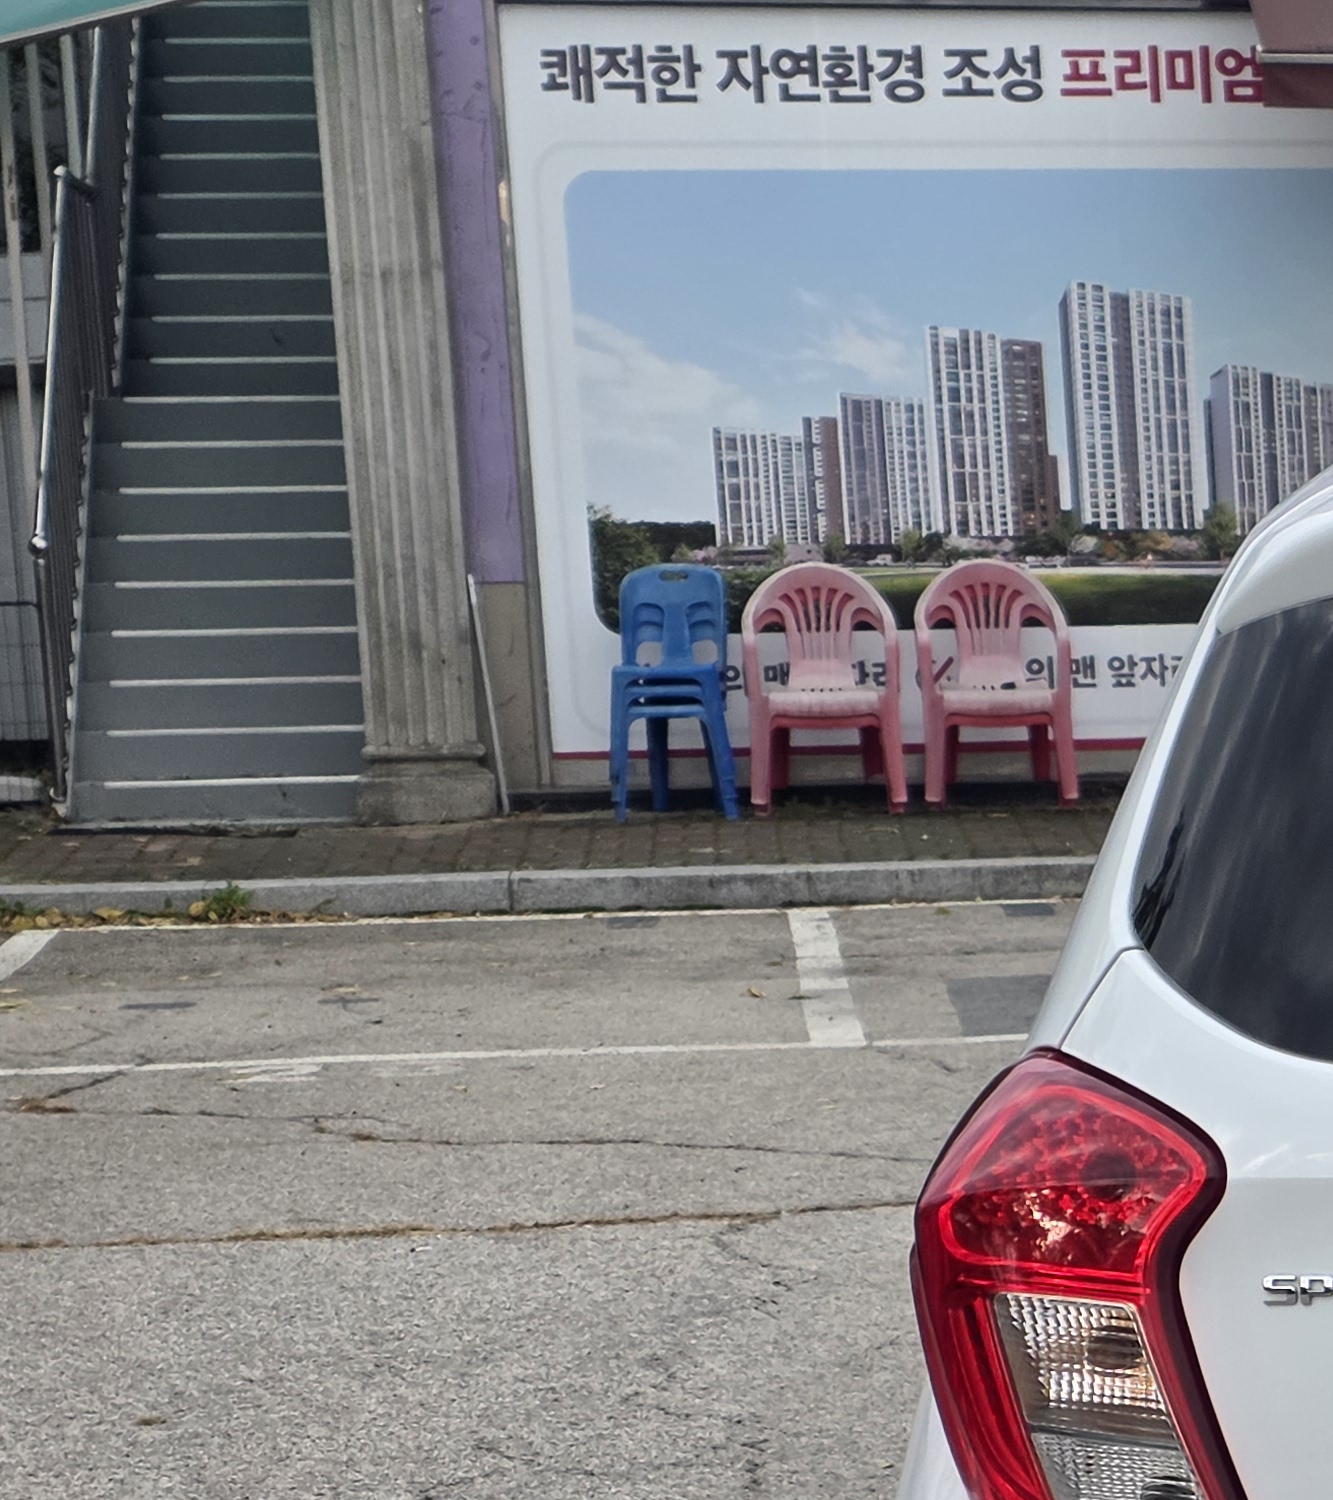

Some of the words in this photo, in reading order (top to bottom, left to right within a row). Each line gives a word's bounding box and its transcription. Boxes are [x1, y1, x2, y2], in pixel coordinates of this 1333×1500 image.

[539, 43, 701, 105] 쾌적한
[716, 44, 926, 104] 자연환경
[941, 44, 1044, 102] 조성
[1060, 46, 1263, 104] 프리미엄
